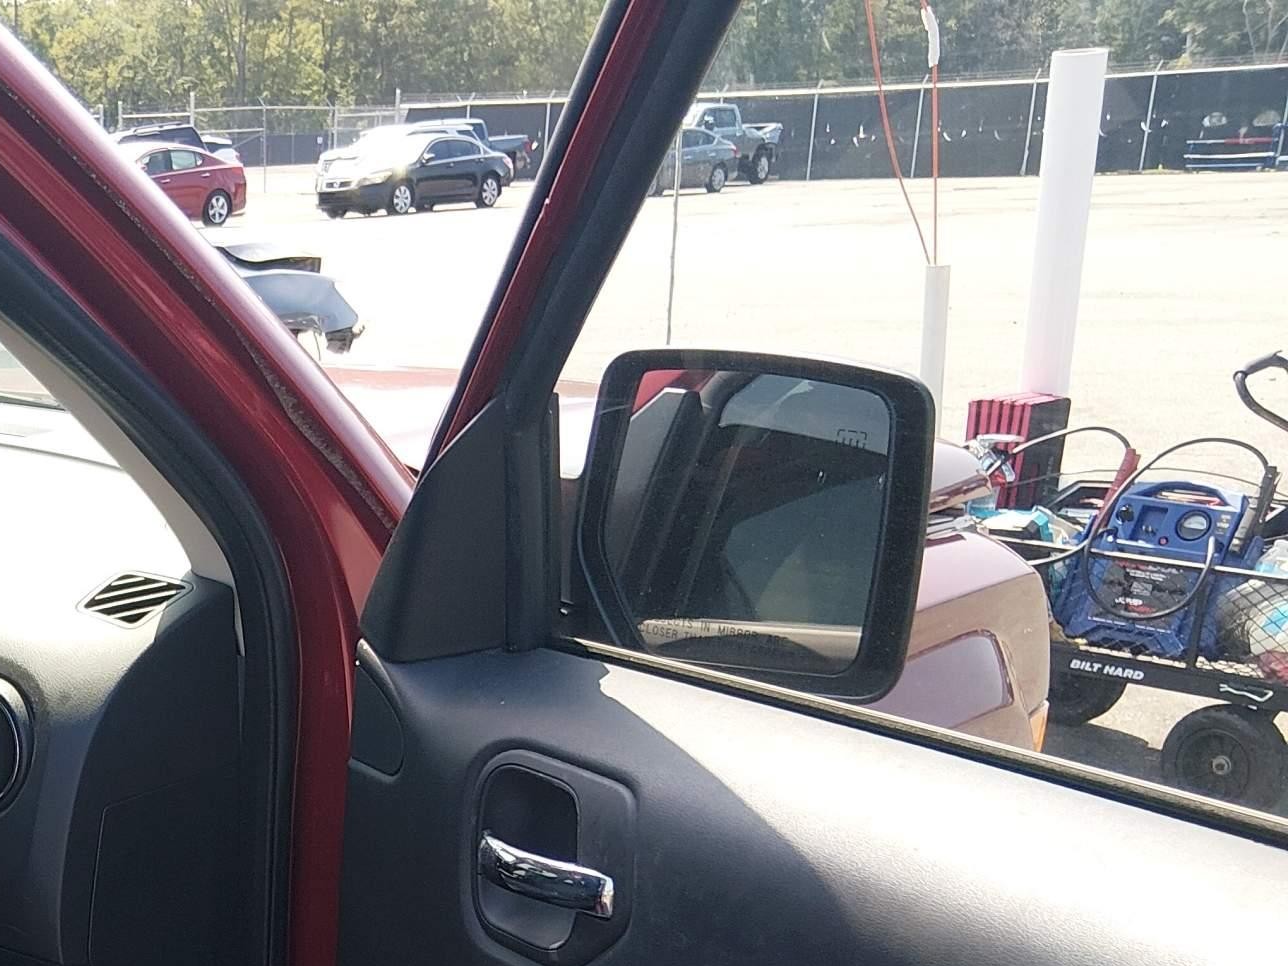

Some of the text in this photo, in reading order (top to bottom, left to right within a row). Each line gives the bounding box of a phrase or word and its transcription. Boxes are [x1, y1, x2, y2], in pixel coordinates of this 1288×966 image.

[638, 622, 679, 639] CLOSER
[700, 619, 710, 632] IN
[1070, 658, 1145, 681] BILT HARD
